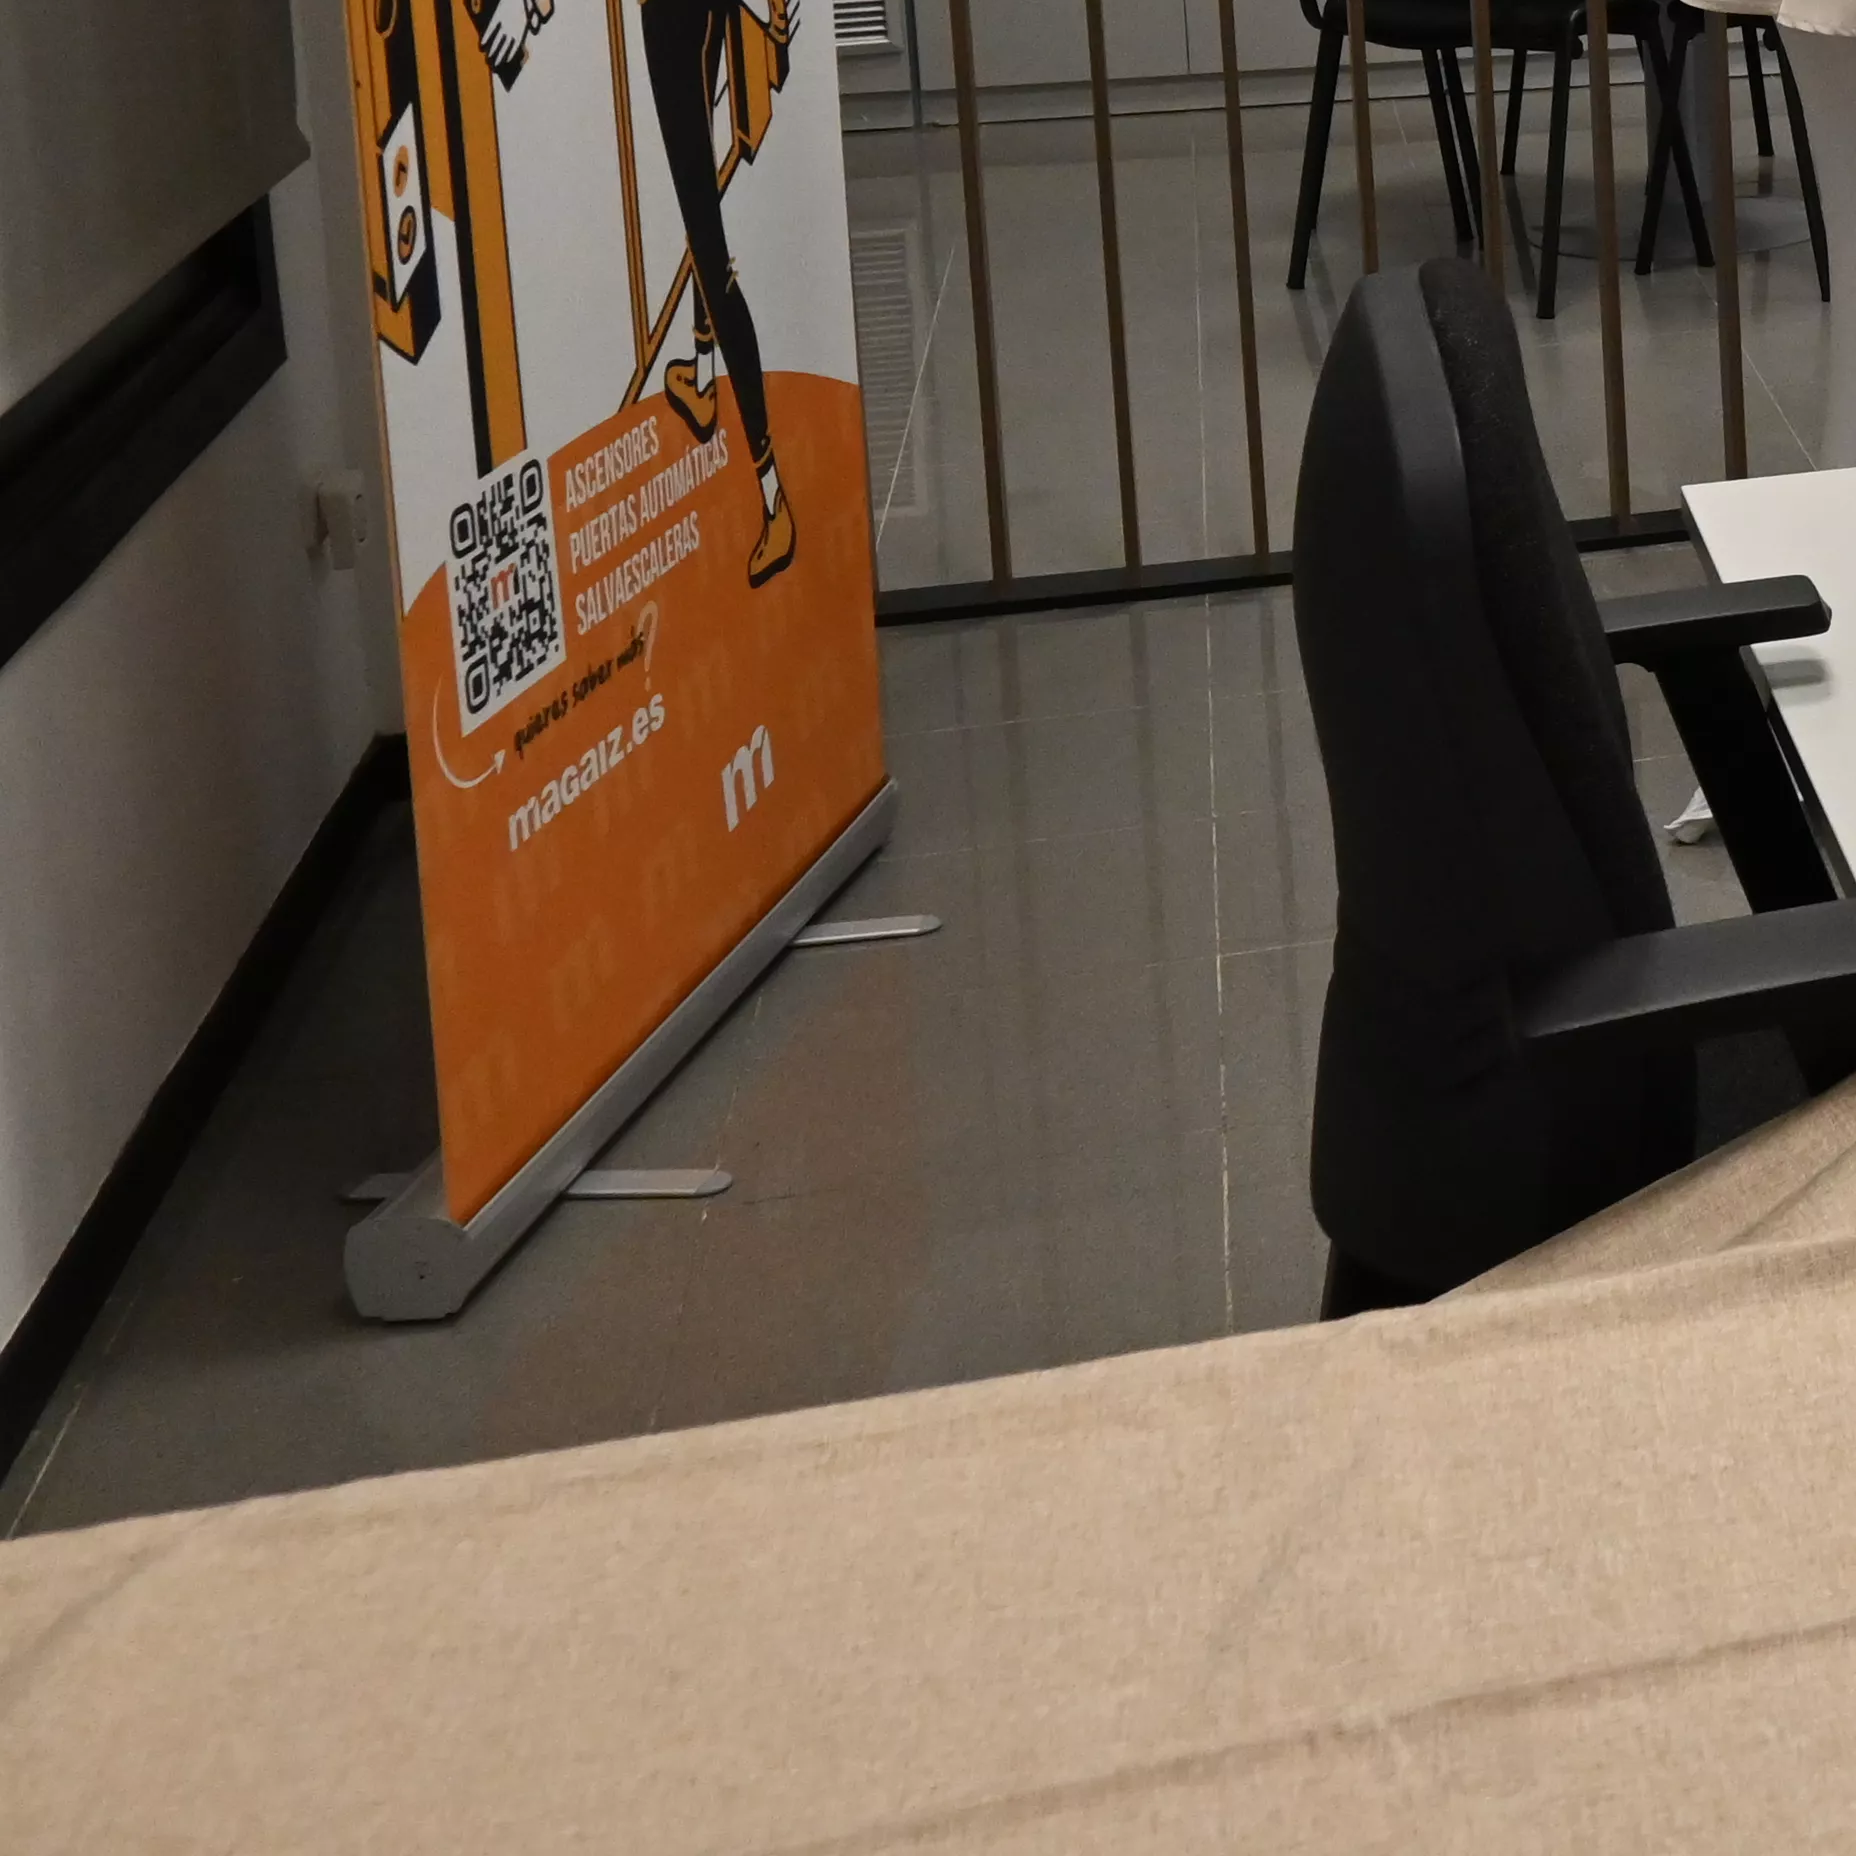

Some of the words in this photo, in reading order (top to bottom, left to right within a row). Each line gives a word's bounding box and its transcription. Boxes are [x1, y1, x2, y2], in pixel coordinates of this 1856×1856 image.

[565, 415, 660, 513] ASCENSORES
[569, 494, 637, 574] PUERTAS
[640, 428, 729, 528] AUTOMÁTICAS
[574, 510, 700, 636] SALVAESCALERAS
